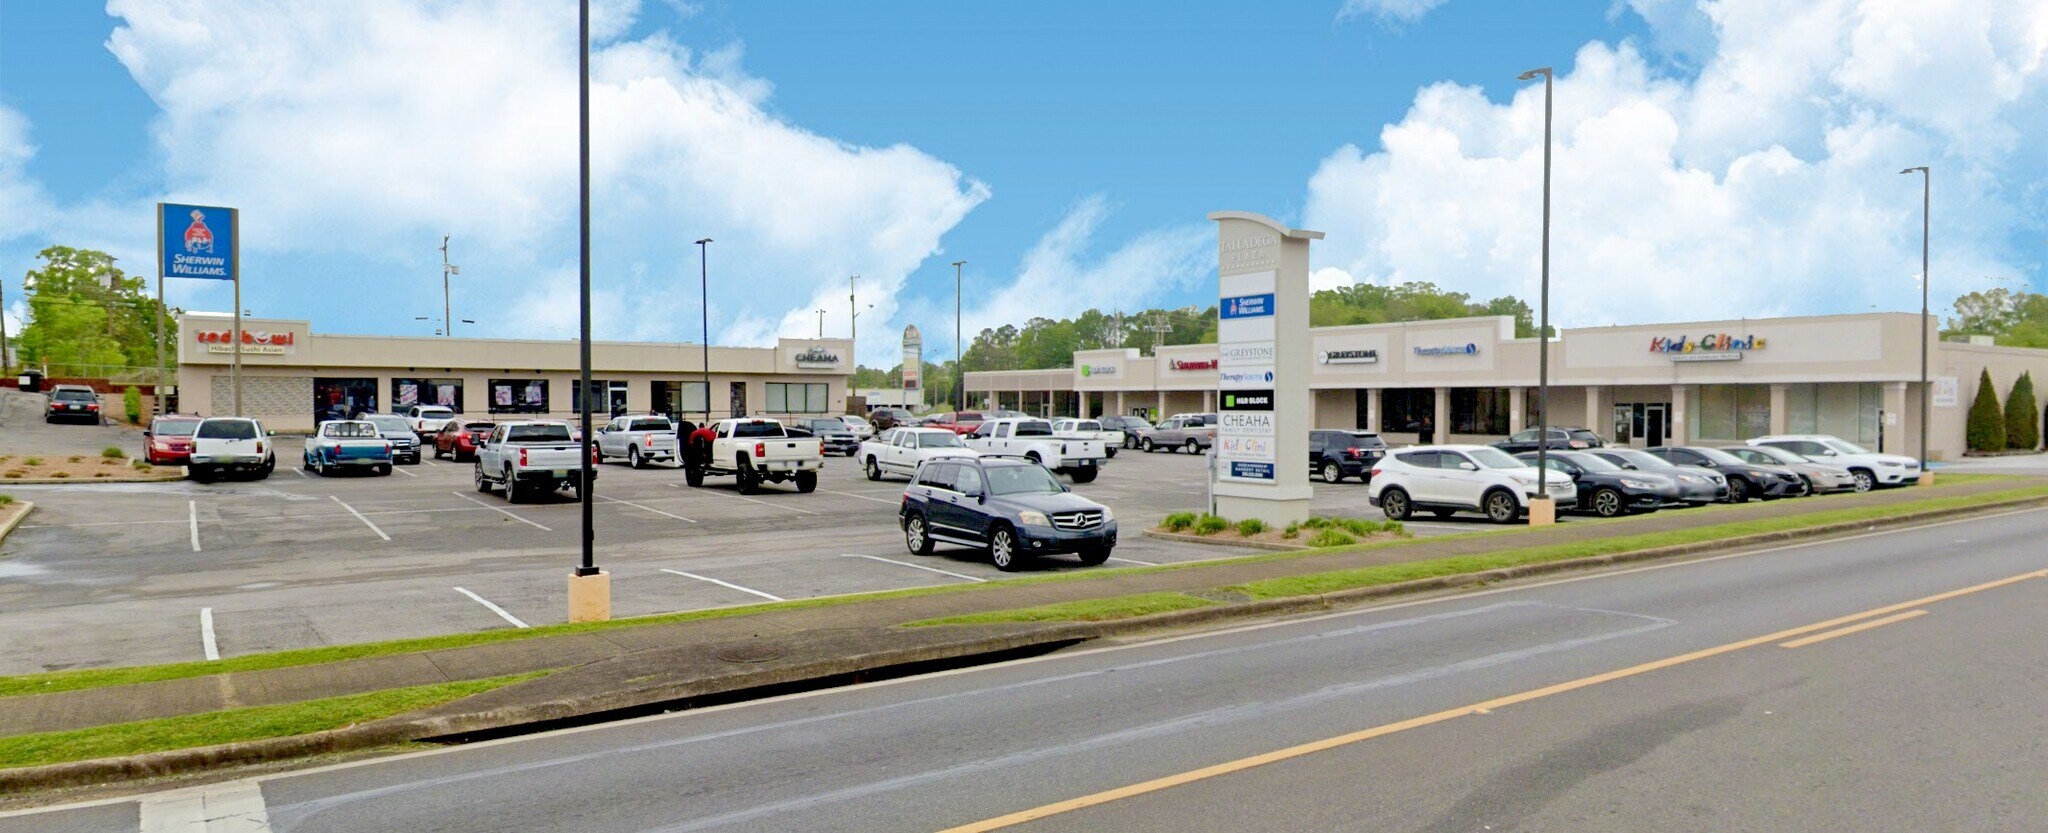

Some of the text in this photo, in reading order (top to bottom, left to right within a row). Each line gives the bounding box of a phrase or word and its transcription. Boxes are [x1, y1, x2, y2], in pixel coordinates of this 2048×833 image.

[1221, 234, 1277, 252] TALLADEGA
[173, 254, 225, 266] SHERWIN
[1239, 297, 1264, 306] SHERWIN
[197, 329, 232, 344] red
[1649, 333, 1766, 353] Kids Clinic
[795, 353, 839, 363] CHEAHA
[1230, 347, 1273, 357] GREYSTONE
[1223, 414, 1271, 427] CHEAHA
